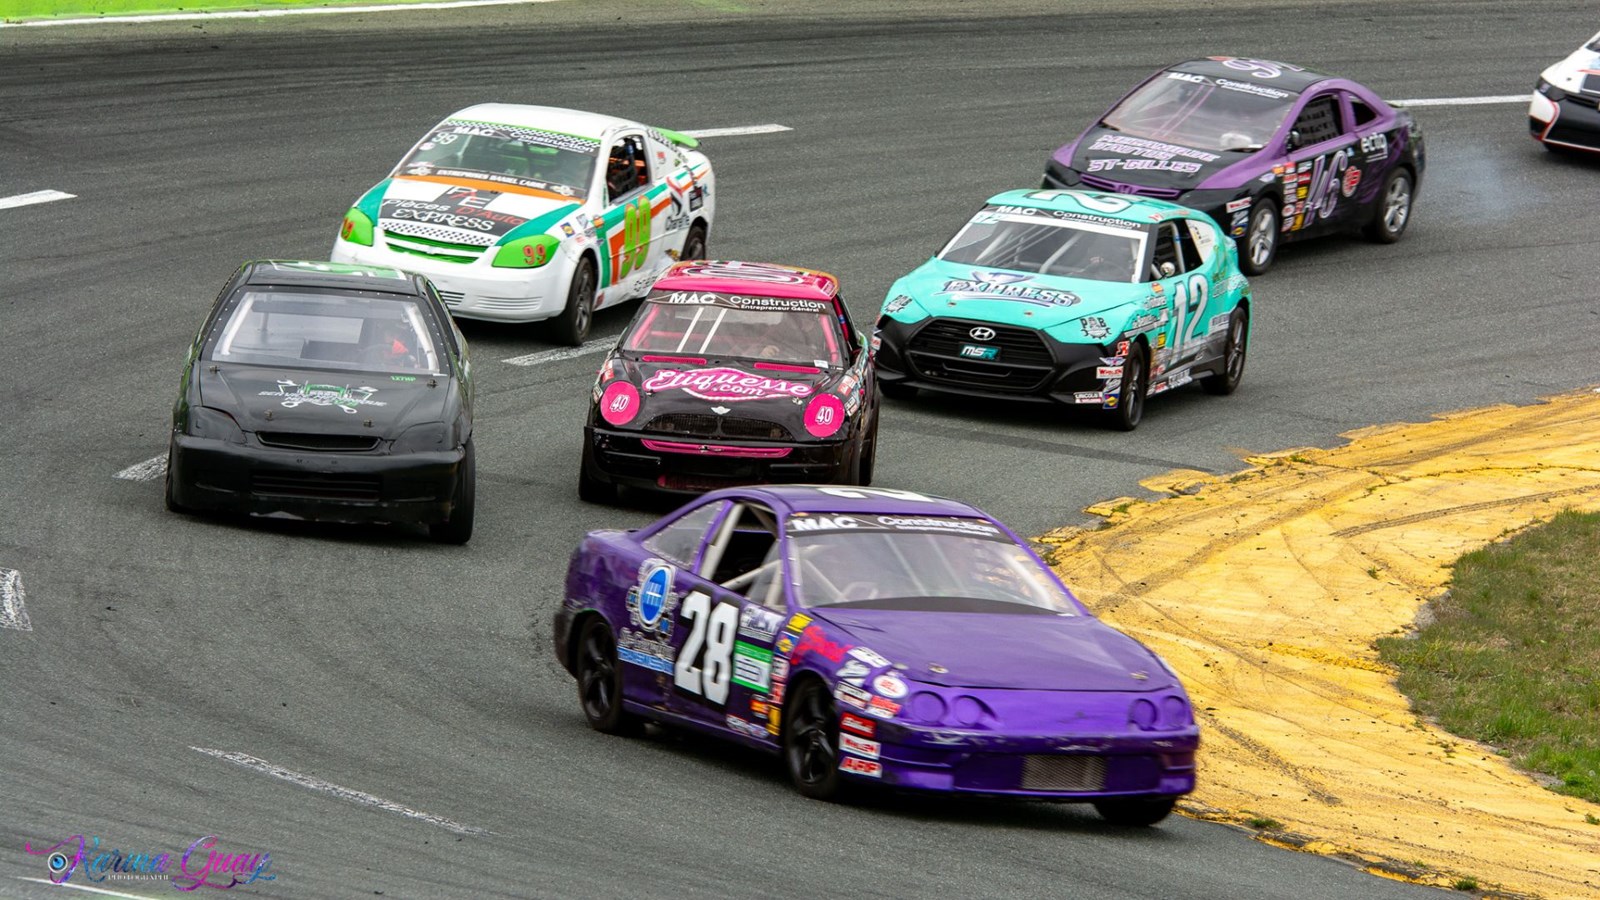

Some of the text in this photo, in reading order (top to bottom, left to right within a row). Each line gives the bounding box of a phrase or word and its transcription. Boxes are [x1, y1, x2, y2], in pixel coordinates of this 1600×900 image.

[1167, 72, 1205, 83] MAC
[431, 131, 458, 145] 99
[453, 126, 496, 137] MAC
[510, 131, 595, 153] Construction
[1087, 158, 1203, 173] ST-GILLES
[391, 208, 496, 232] EXPRESS
[995, 205, 1038, 216] MAC
[1052, 210, 1142, 229] Construction
[619, 194, 652, 280] 99
[522, 243, 547, 266] 99
[668, 292, 826, 310] MAC Construction
[942, 279, 1078, 307] EXPRESS
[740, 304, 791, 312] Entrepreneur
[1169, 272, 1209, 367] 12
[961, 345, 999, 360] MSR
[644, 368, 813, 397] Etiquesse
[610, 394, 630, 413] 40
[814, 405, 835, 425] 40
[791, 516, 859, 531] MAC
[876, 516, 1000, 534] Construction
[674, 590, 740, 706] 28
